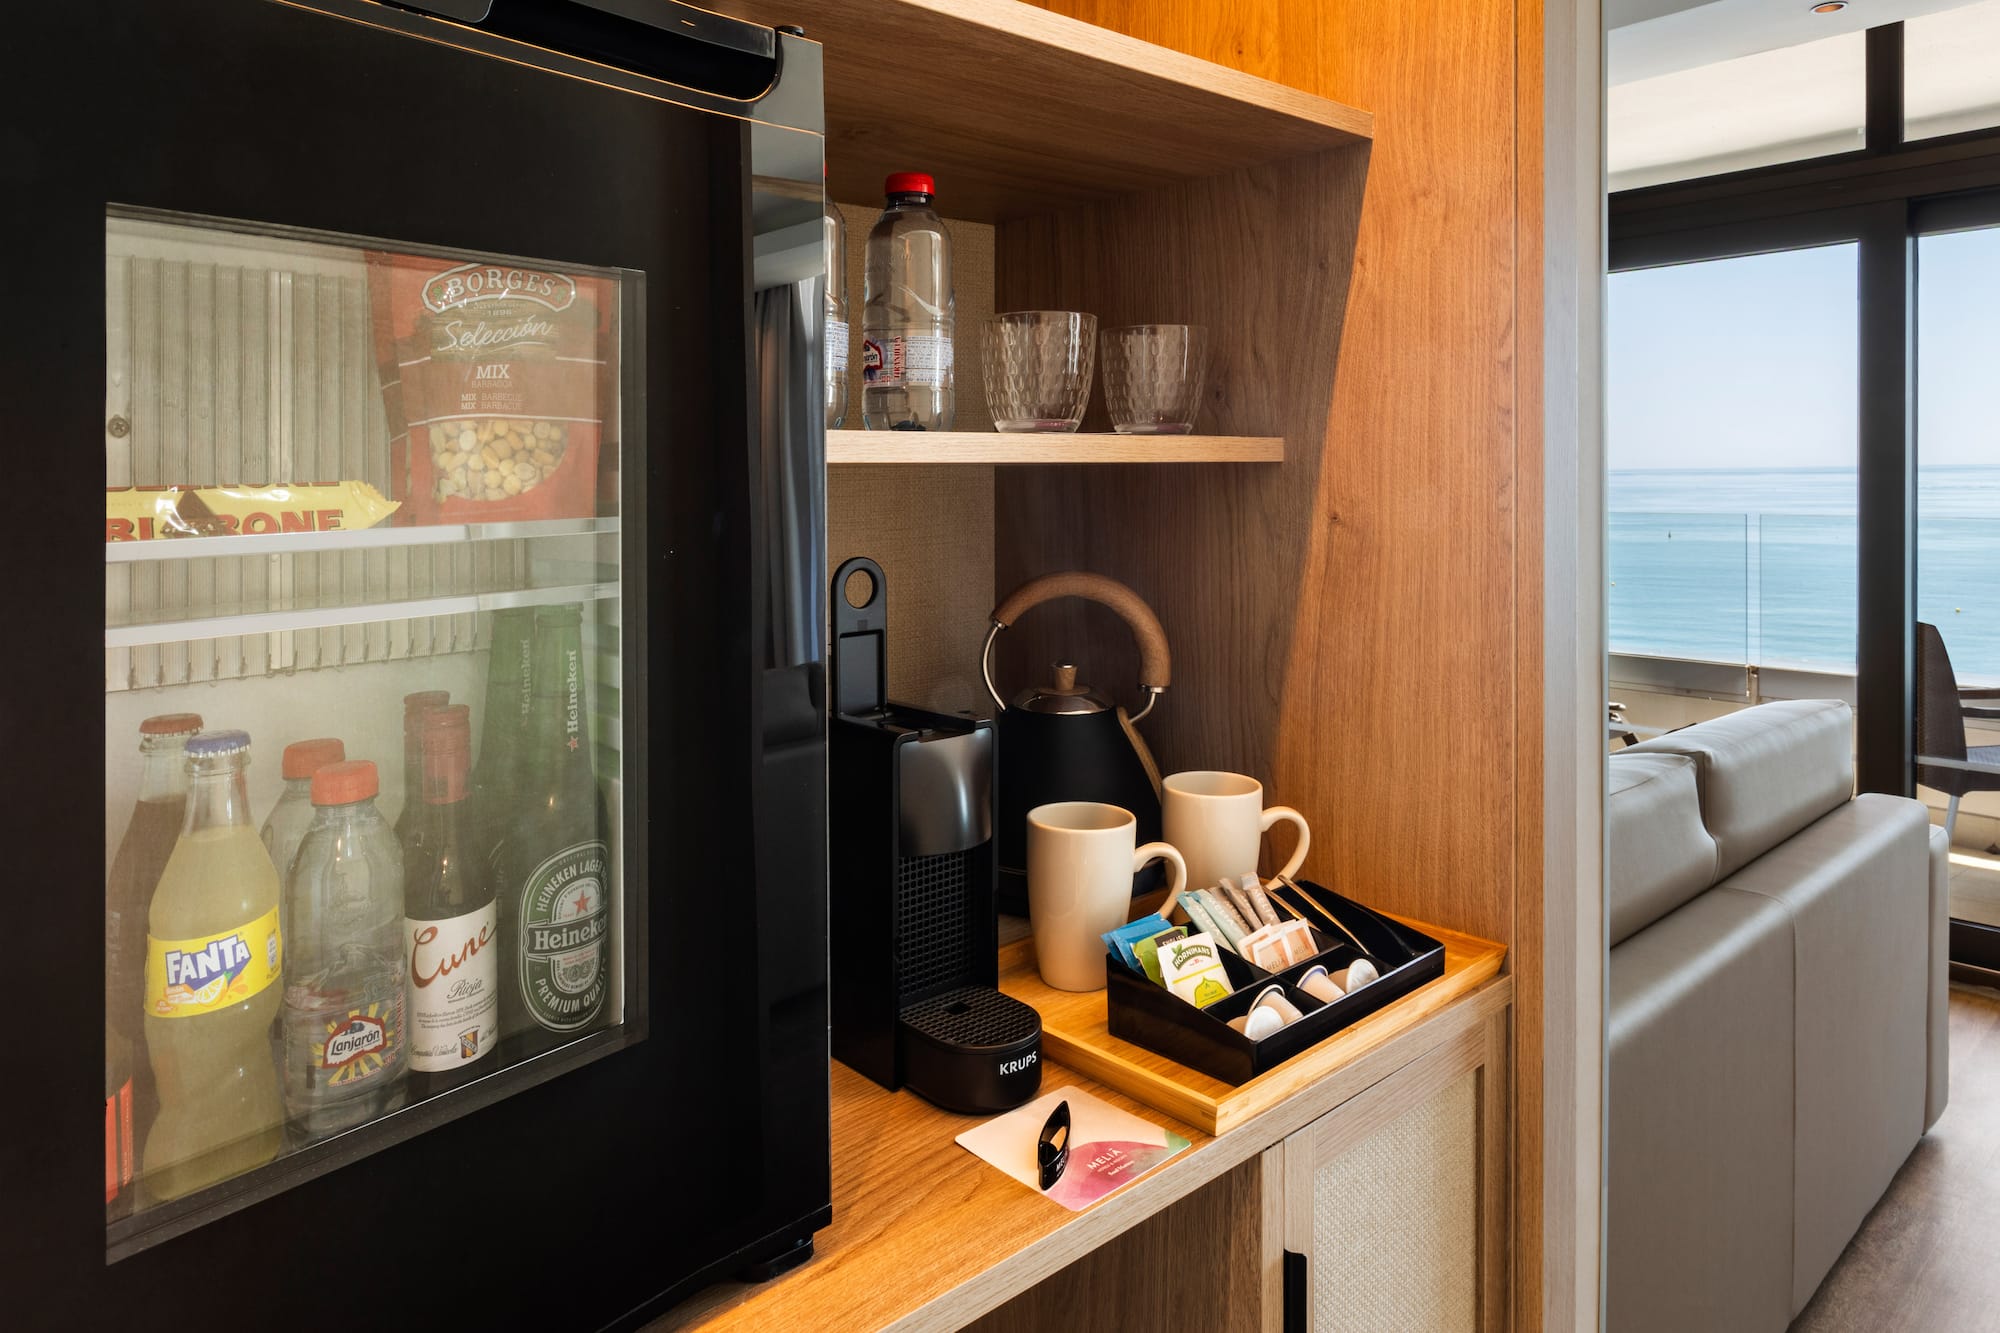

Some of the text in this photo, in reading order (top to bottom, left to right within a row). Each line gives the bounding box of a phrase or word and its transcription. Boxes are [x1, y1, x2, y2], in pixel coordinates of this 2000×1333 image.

[446, 268, 556, 297] BORGES
[437, 314, 553, 351] Selección
[475, 364, 511, 380] MIX
[461, 393, 477, 401] MIX
[461, 402, 477, 410] MIX
[566, 649, 579, 734] Heineken
[536, 863, 577, 913] HEINEKEN
[165, 934, 251, 986] FANTA
[1173, 945, 1211, 968] HORNIMANS
[446, 977, 484, 1000] Rioja
[536, 978, 580, 1014] PREMIUM
[331, 1029, 380, 1057] Lanjarón
[999, 1050, 1037, 1076] KRUPS
